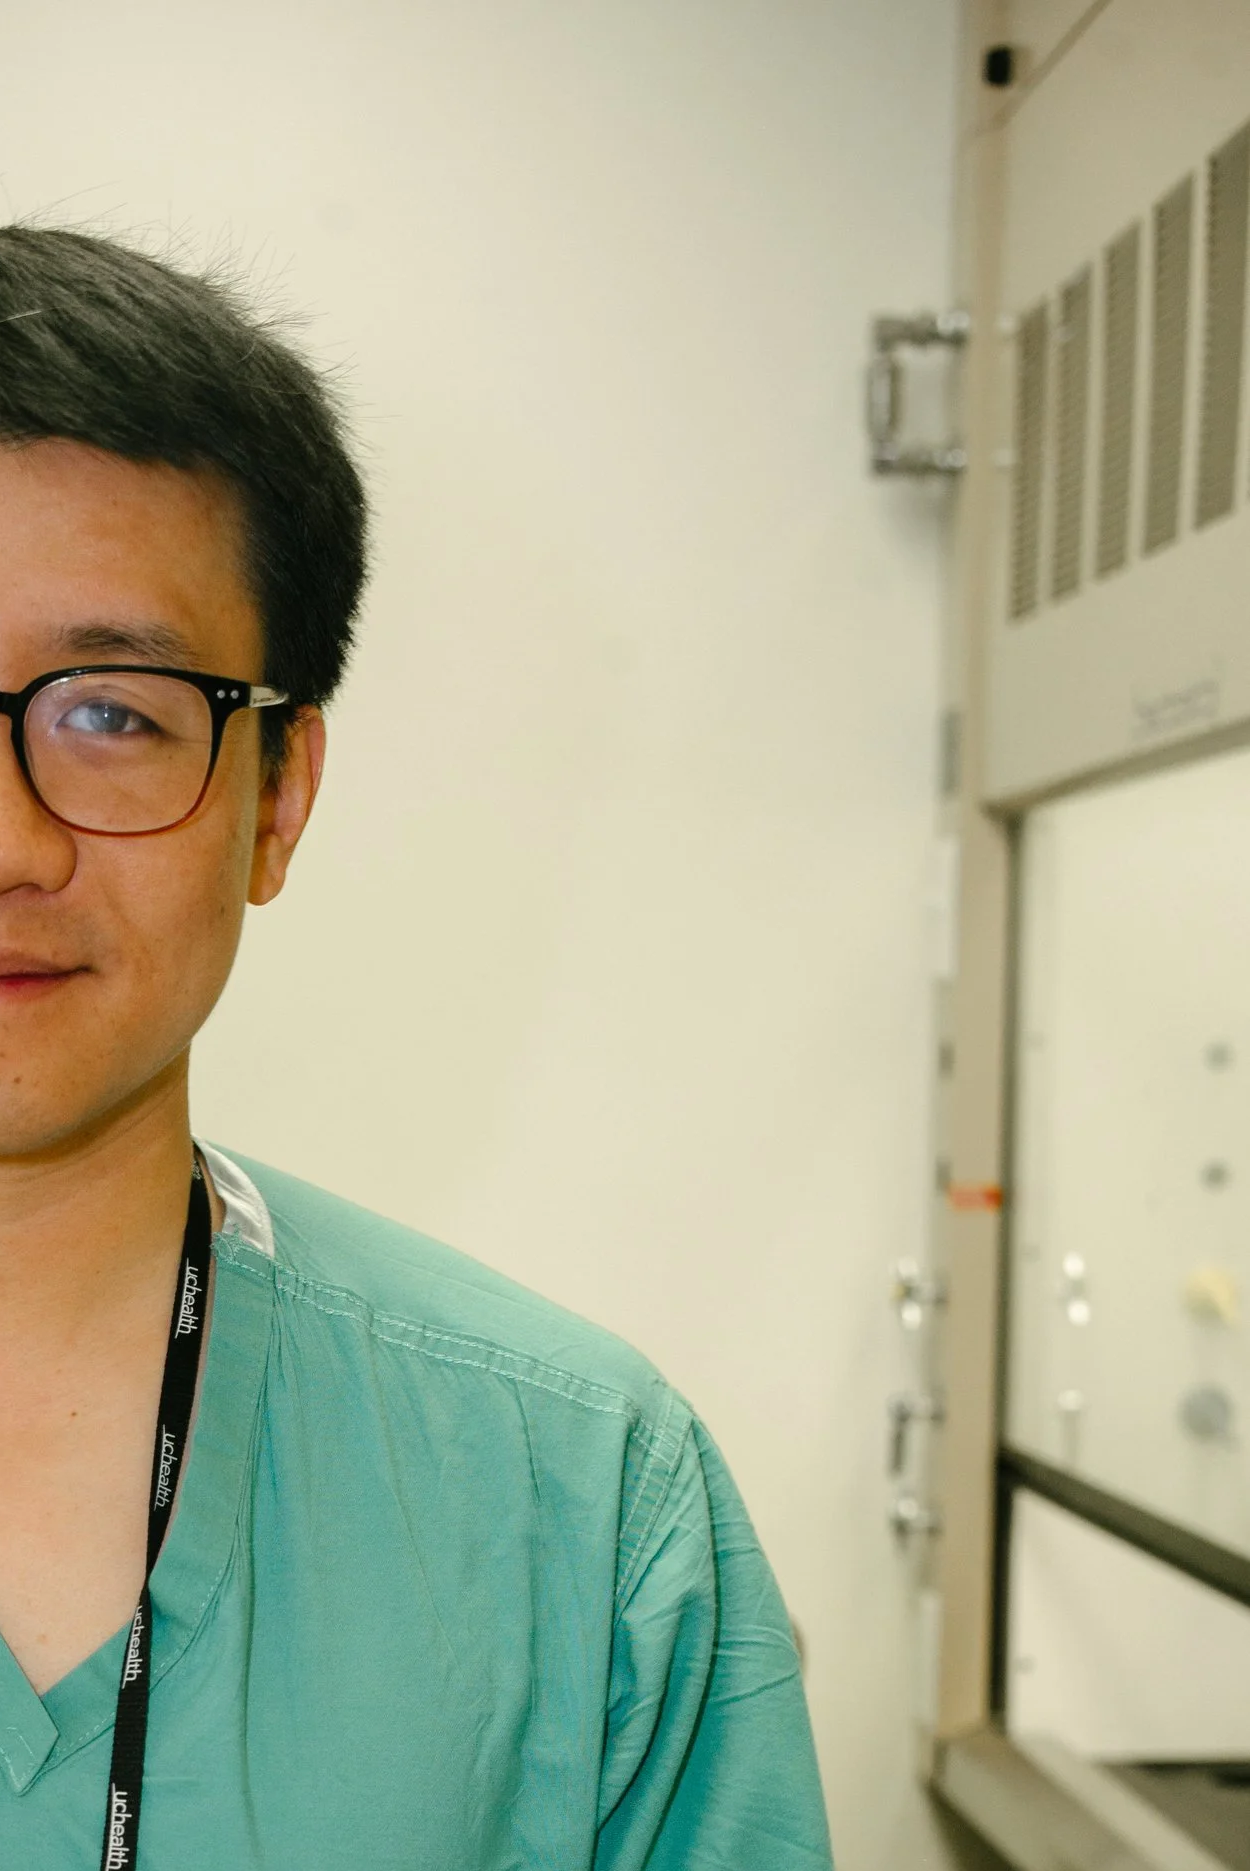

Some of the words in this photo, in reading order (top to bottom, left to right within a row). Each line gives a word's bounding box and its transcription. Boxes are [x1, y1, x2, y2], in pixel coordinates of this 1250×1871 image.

[175, 1259, 200, 1339] uchealth
[154, 1425, 179, 1511] uchealth
[122, 1605, 146, 1689] uchealth
